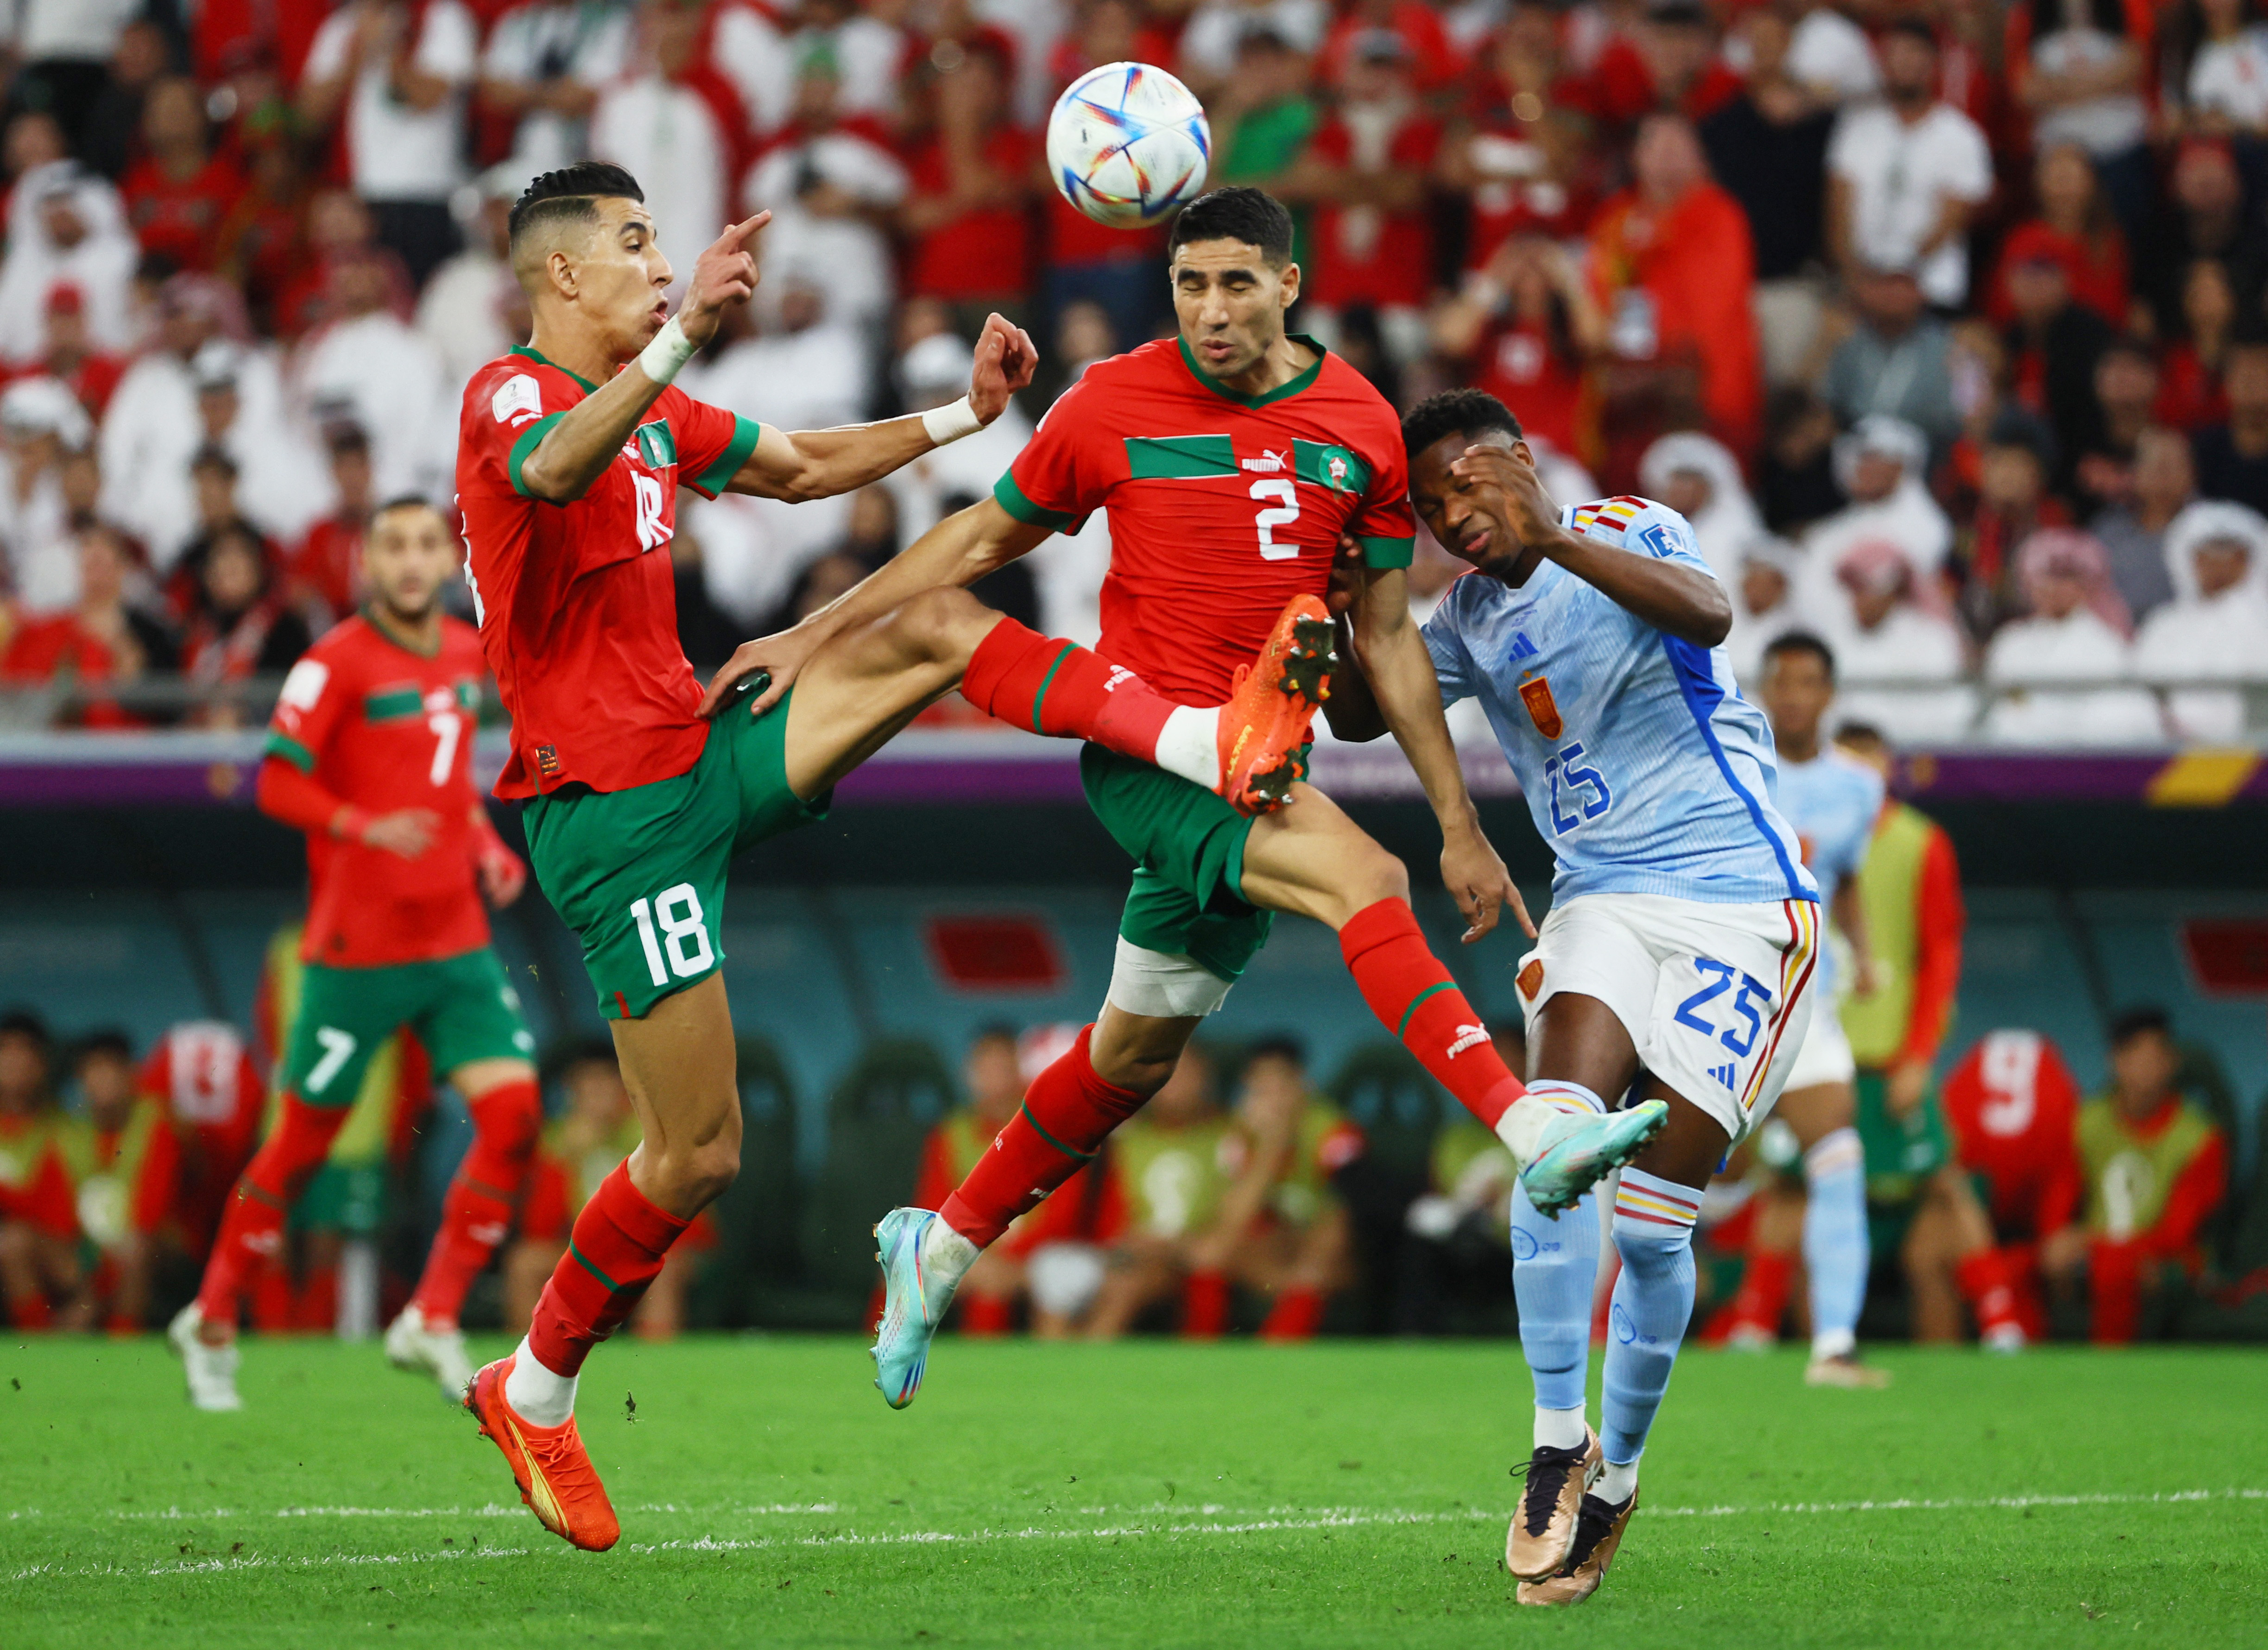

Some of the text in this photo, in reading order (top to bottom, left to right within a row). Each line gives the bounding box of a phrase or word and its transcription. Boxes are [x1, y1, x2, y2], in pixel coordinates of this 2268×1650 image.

[1249, 478, 1300, 561] 2
[429, 713, 461, 787] 7
[1544, 740, 1613, 838] 25
[630, 882, 715, 987] 18
[1674, 957, 1772, 1058] 25
[305, 1025, 357, 1095] 7
[1980, 1028, 2041, 1137] 9
